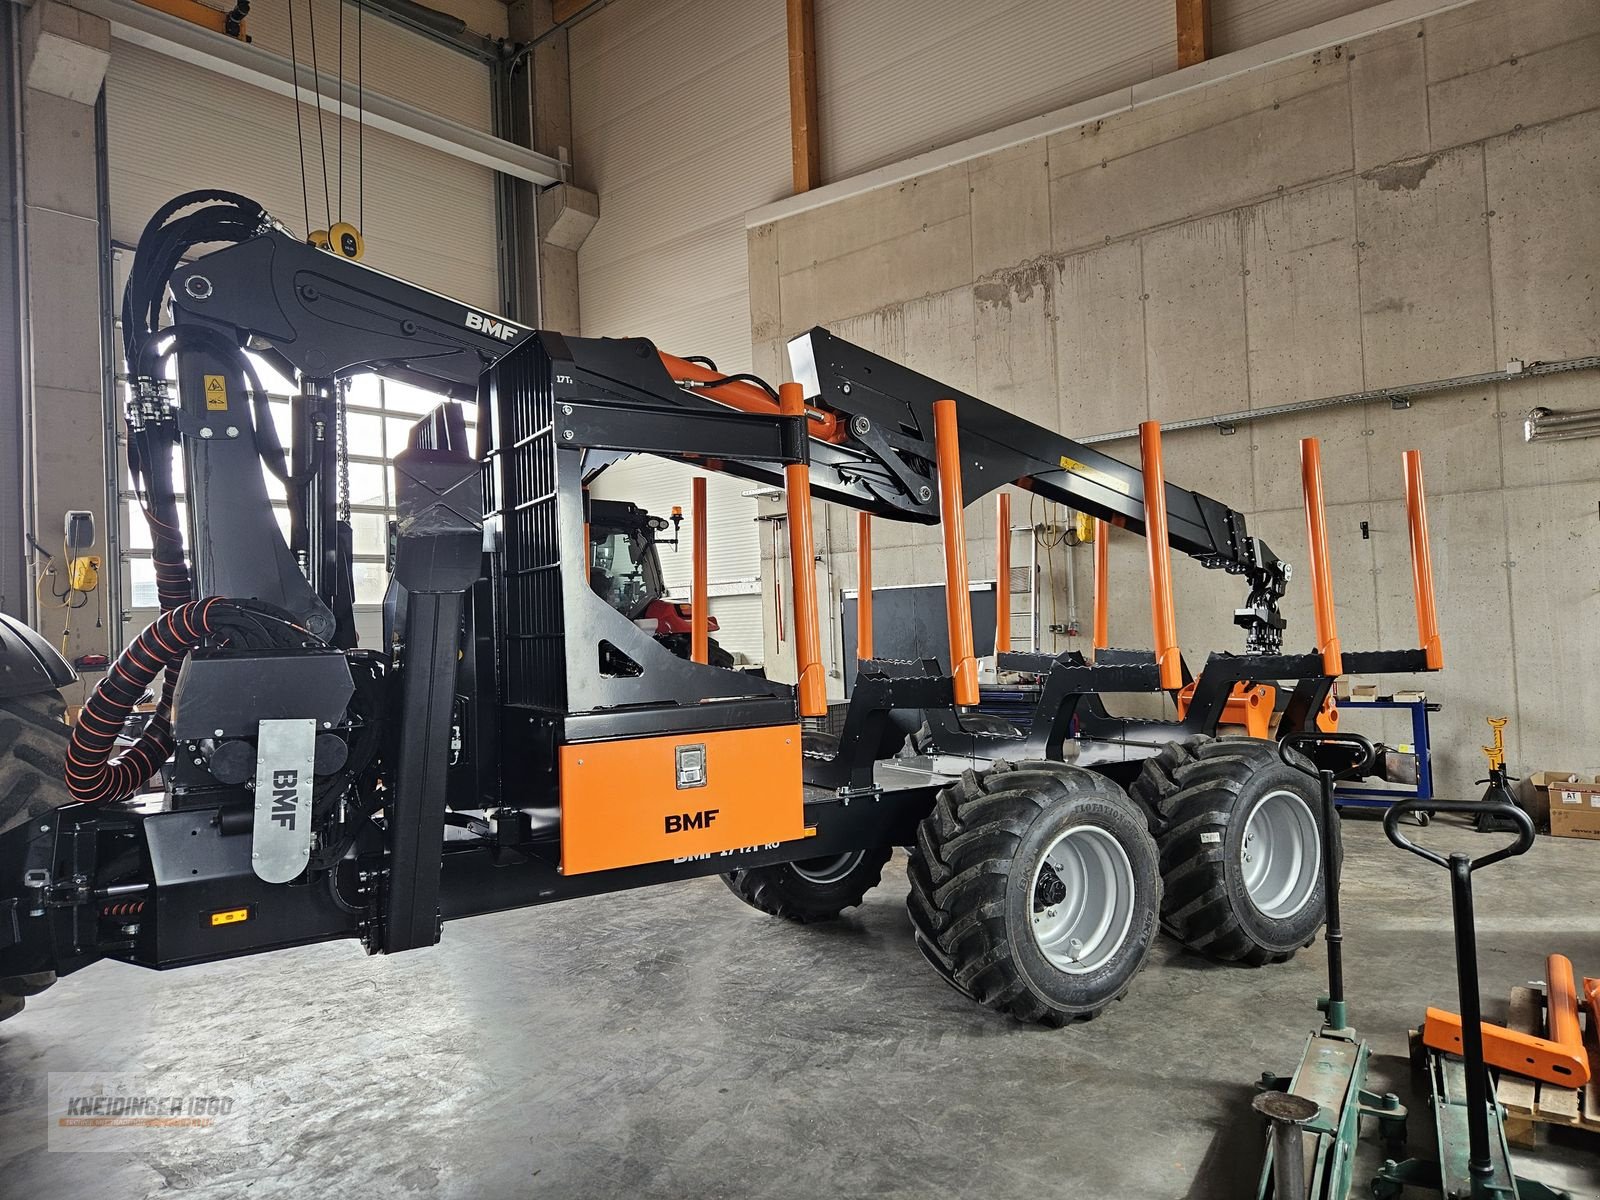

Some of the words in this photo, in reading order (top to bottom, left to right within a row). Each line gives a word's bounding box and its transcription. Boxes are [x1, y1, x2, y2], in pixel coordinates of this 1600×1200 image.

[464, 311, 519, 341] BMF
[271, 769, 298, 831] BMF
[664, 809, 720, 834] BMF
